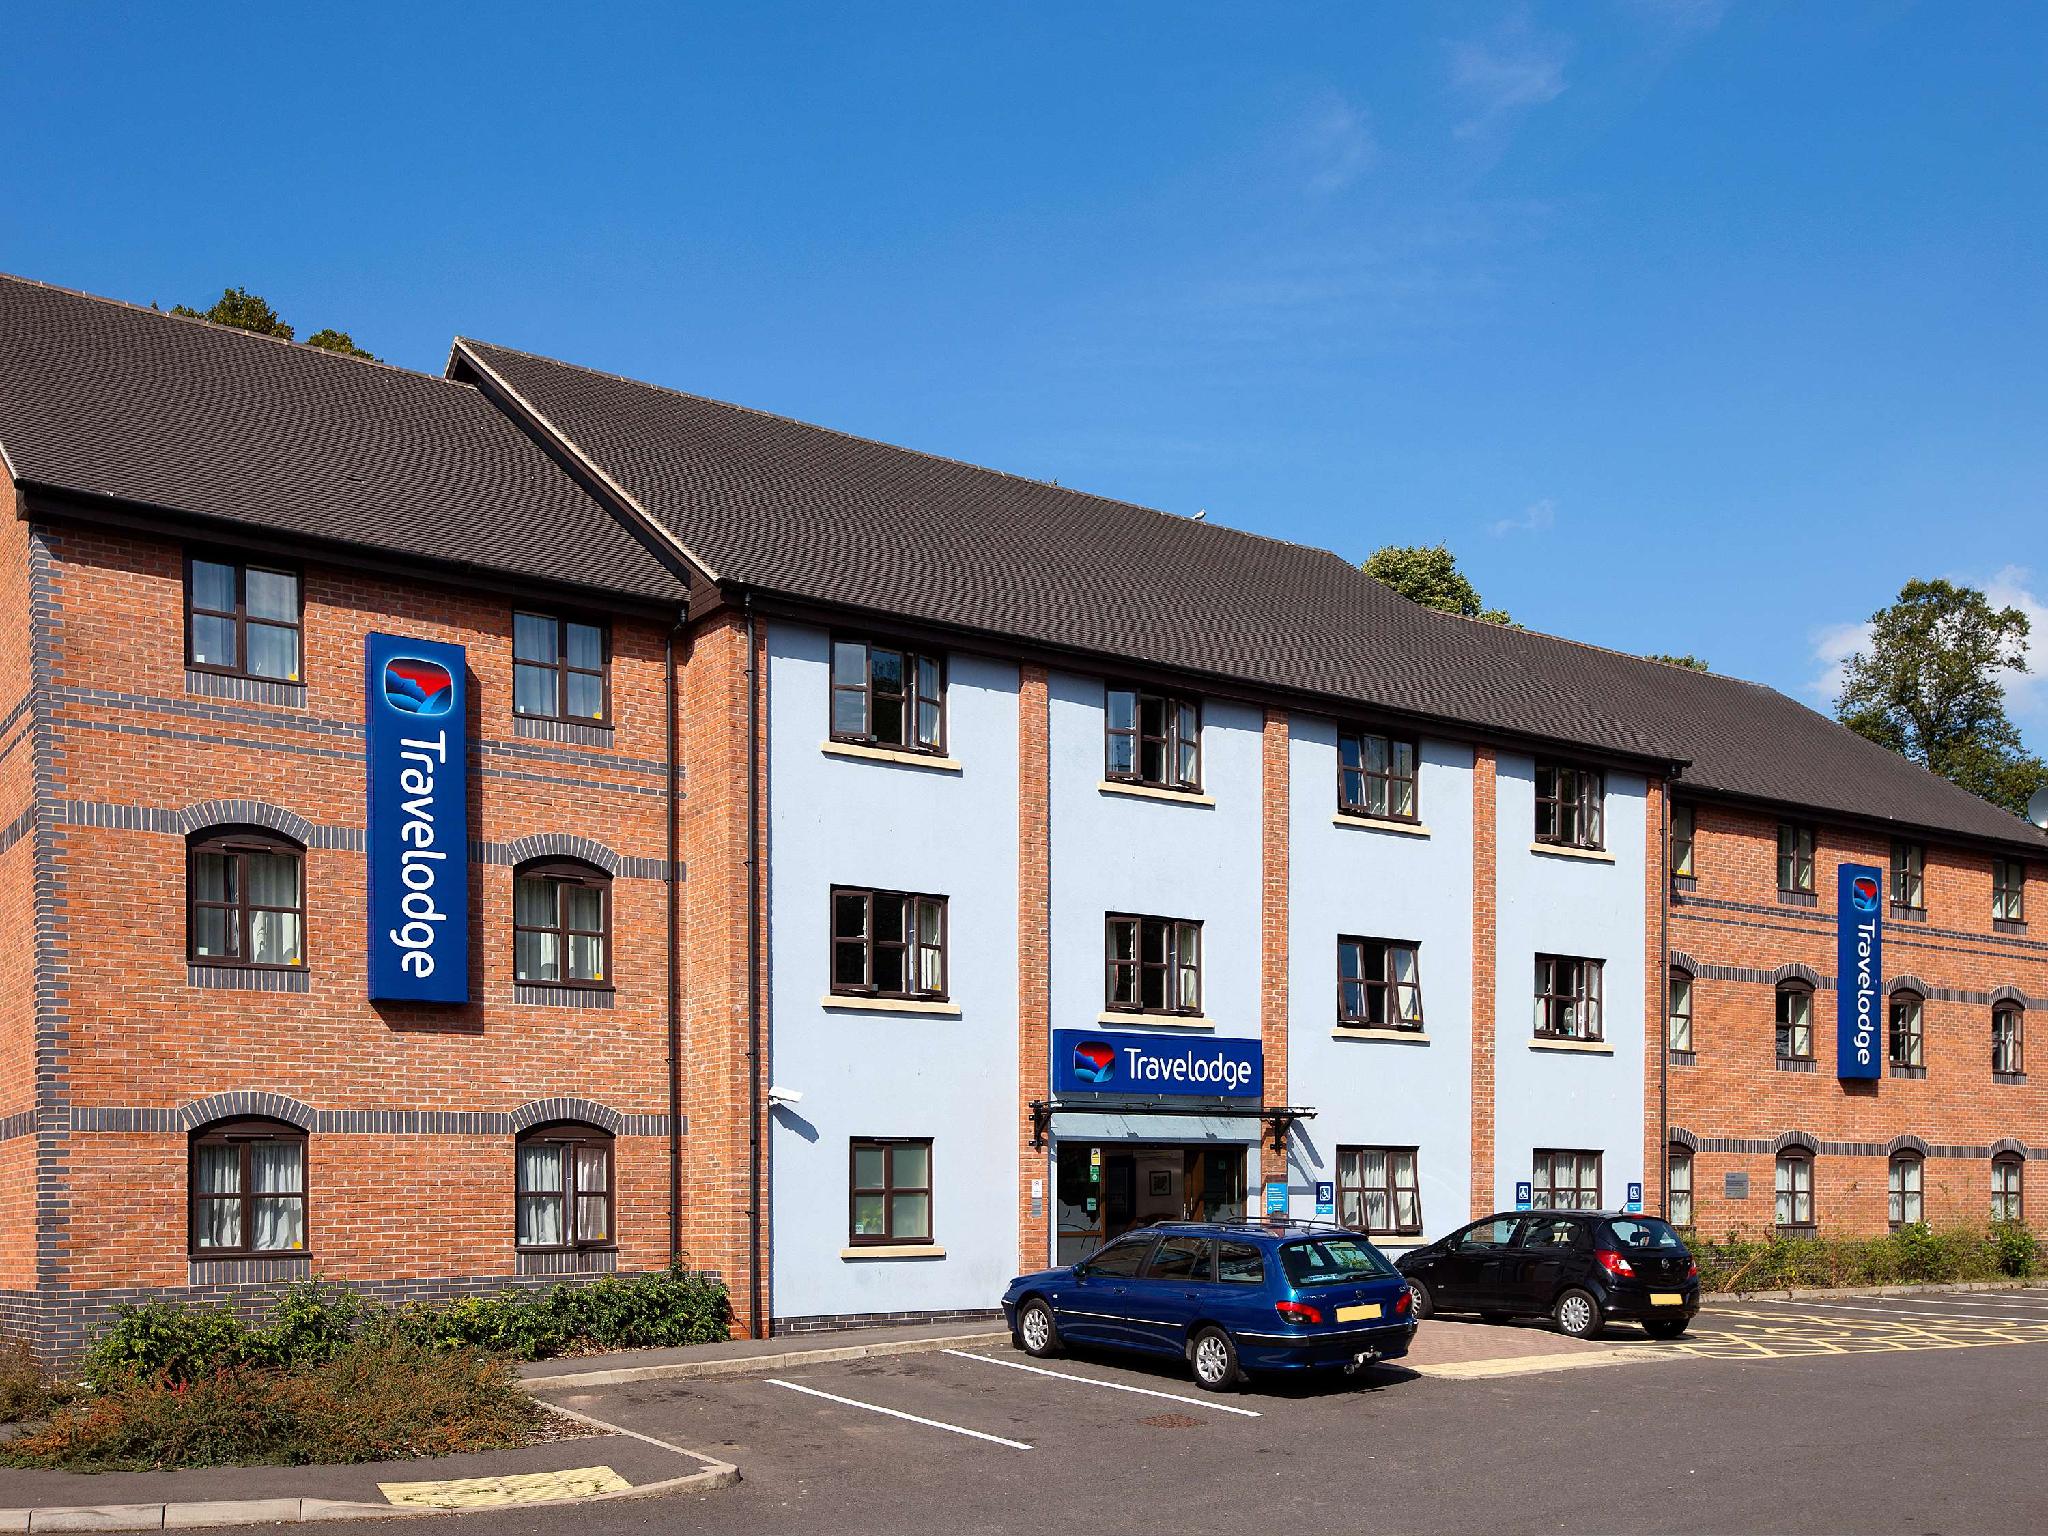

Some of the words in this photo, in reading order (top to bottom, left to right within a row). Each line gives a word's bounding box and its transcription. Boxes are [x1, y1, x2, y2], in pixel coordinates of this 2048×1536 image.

[389, 729, 447, 979] Travelodge
[1853, 918, 1875, 1065] Travelodge
[1123, 1047, 1252, 1091] Travelodge
